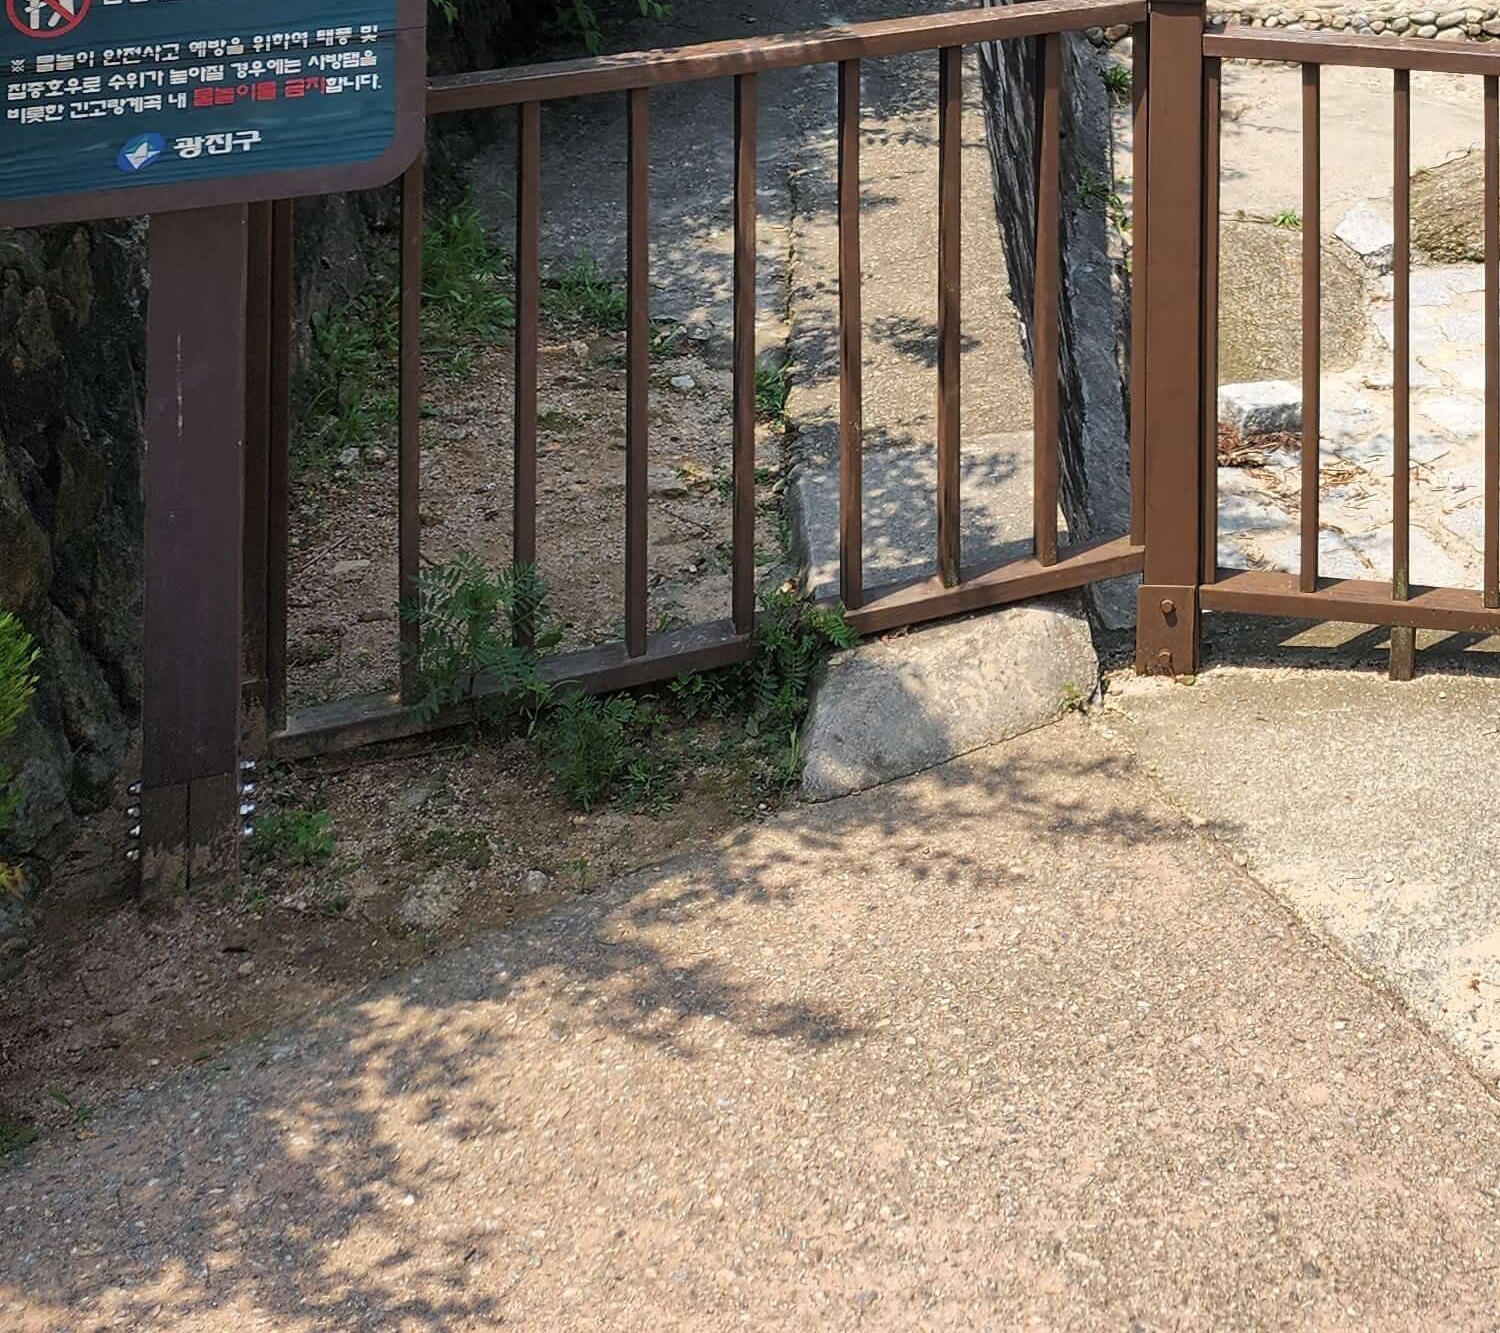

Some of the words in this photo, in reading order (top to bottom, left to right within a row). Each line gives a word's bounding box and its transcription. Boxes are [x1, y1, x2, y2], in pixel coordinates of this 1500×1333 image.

[36, 50, 95, 73] 물놀이
[103, 42, 180, 66] 안전사고
[189, 36, 245, 58] 예방을
[252, 31, 308, 52] 위하여
[316, 26, 353, 46] 태풍
[360, 24, 378, 43] 및
[7, 75, 101, 101] 집중호우로
[108, 69, 164, 91] 수위가
[169, 64, 225, 85] 높아질
[230, 58, 302, 79] 경우에는
[308, 50, 377, 71] 사방댐을
[7, 103, 65, 125] 비롯한
[70, 94, 162, 119] 긴고랑계곡
[168, 92, 187, 109] 내
[193, 80, 277, 107] 물놀이를
[173, 129, 263, 159] 광진구
